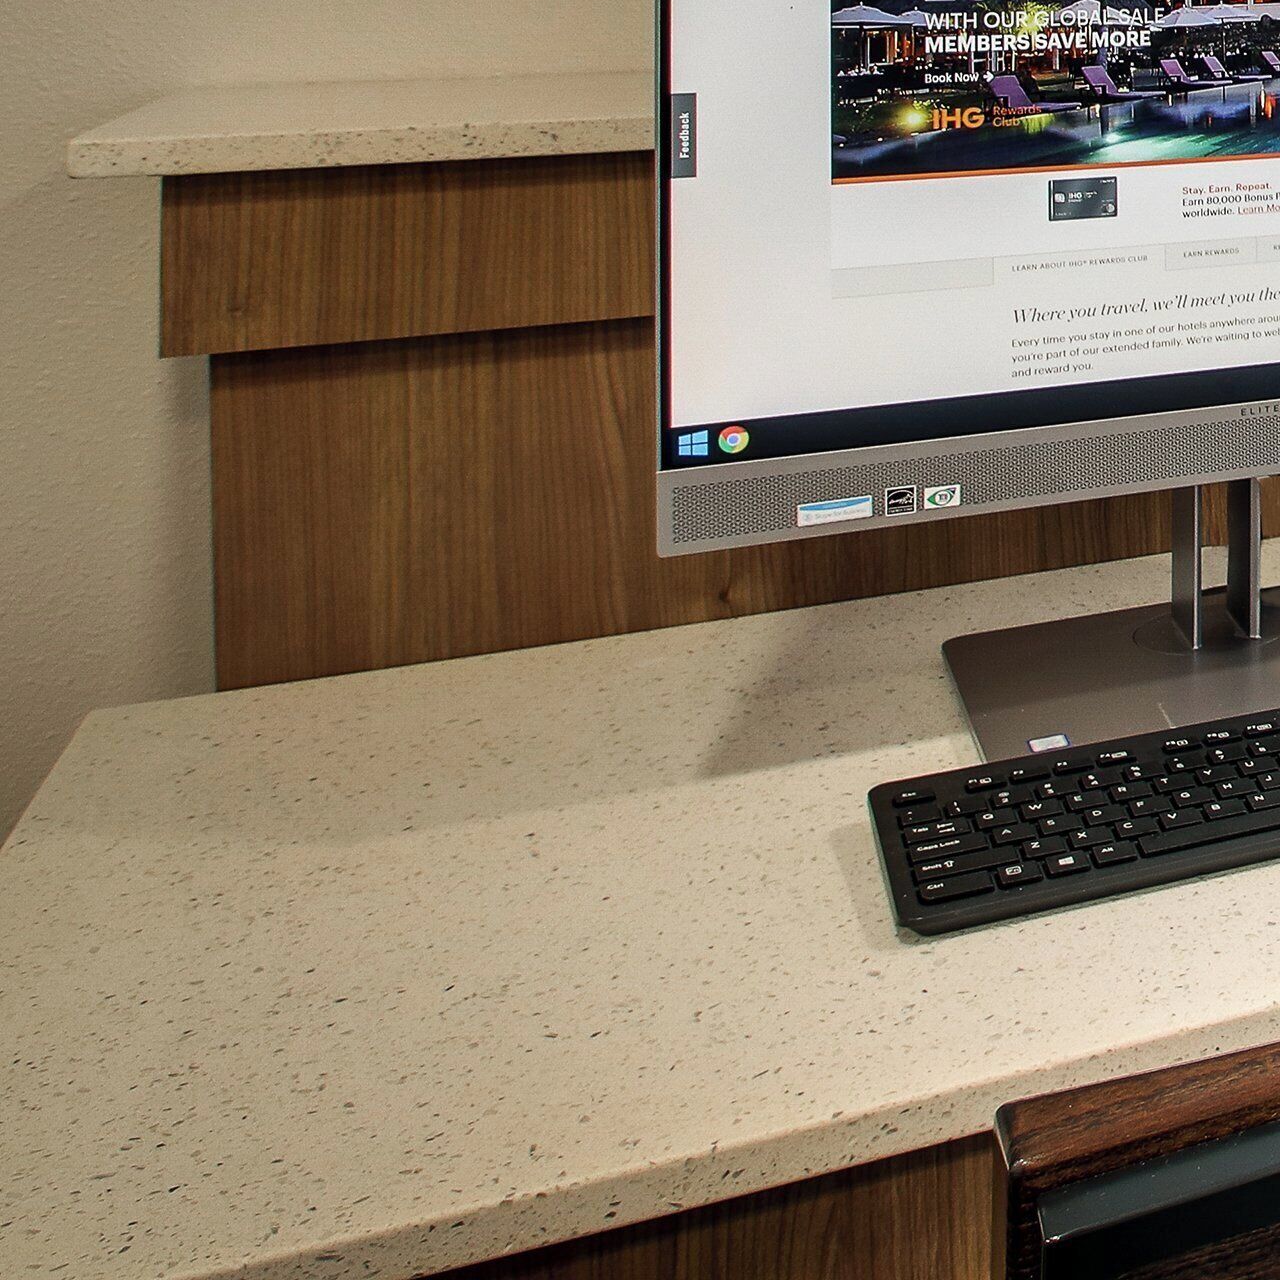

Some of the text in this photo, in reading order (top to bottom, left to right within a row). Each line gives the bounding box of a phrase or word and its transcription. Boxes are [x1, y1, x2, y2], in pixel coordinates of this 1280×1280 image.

[924, 7, 1166, 30] WITH OUR GLOBAL SALE
[924, 31, 1151, 54] MEMBERS SAVE MORE
[924, 72, 979, 84] Book Now
[932, 106, 985, 130] IHG
[992, 105, 1042, 116] Rewards
[992, 116, 1020, 127] Club
[679, 111, 690, 160] Feedback
[1182, 185, 1206, 196] Stay.
[1236, 182, 1272, 192] Repeat.
[1182, 197, 1204, 207] Earn
[1206, 195, 1242, 205] 80,000
[1244, 193, 1274, 203] Bonus
[1182, 206, 1235, 218] worldwide.
[1237, 204, 1264, 216] Learn
[1012, 255, 1148, 272] LEARN ABOUT REWARDS CLUB
[1014, 308, 1066, 323] Where
[1067, 307, 1096, 322] you
[1190, 293, 1225, 308] meet
[1227, 292, 1255, 308] you
[1011, 338, 1040, 348] Every
[1043, 335, 1066, 345] time
[1068, 334, 1087, 344] you
[1089, 331, 1110, 341] stay
[1113, 329, 1122, 337] in
[1124, 328, 1143, 336] one
[1146, 325, 1156, 335] of
[1158, 325, 1174, 333] our
[1177, 320, 1207, 331] hotels
[1209, 316, 1255, 329] anywhere
[1011, 352, 1043, 364] you're
[1046, 350, 1066, 361] part
[1069, 347, 1080, 357] of
[1082, 346, 1100, 355] our
[1102, 340, 1150, 353] extended
[1152, 337, 1184, 349] family.
[1186, 335, 1212, 344] We're
[1215, 331, 1250, 342] waiting
[1252, 329, 1261, 338] to
[1011, 363, 1093, 378] and reward you.
[916, 840, 960, 852] Caps Lock
[927, 883, 944, 891] Ctrl
